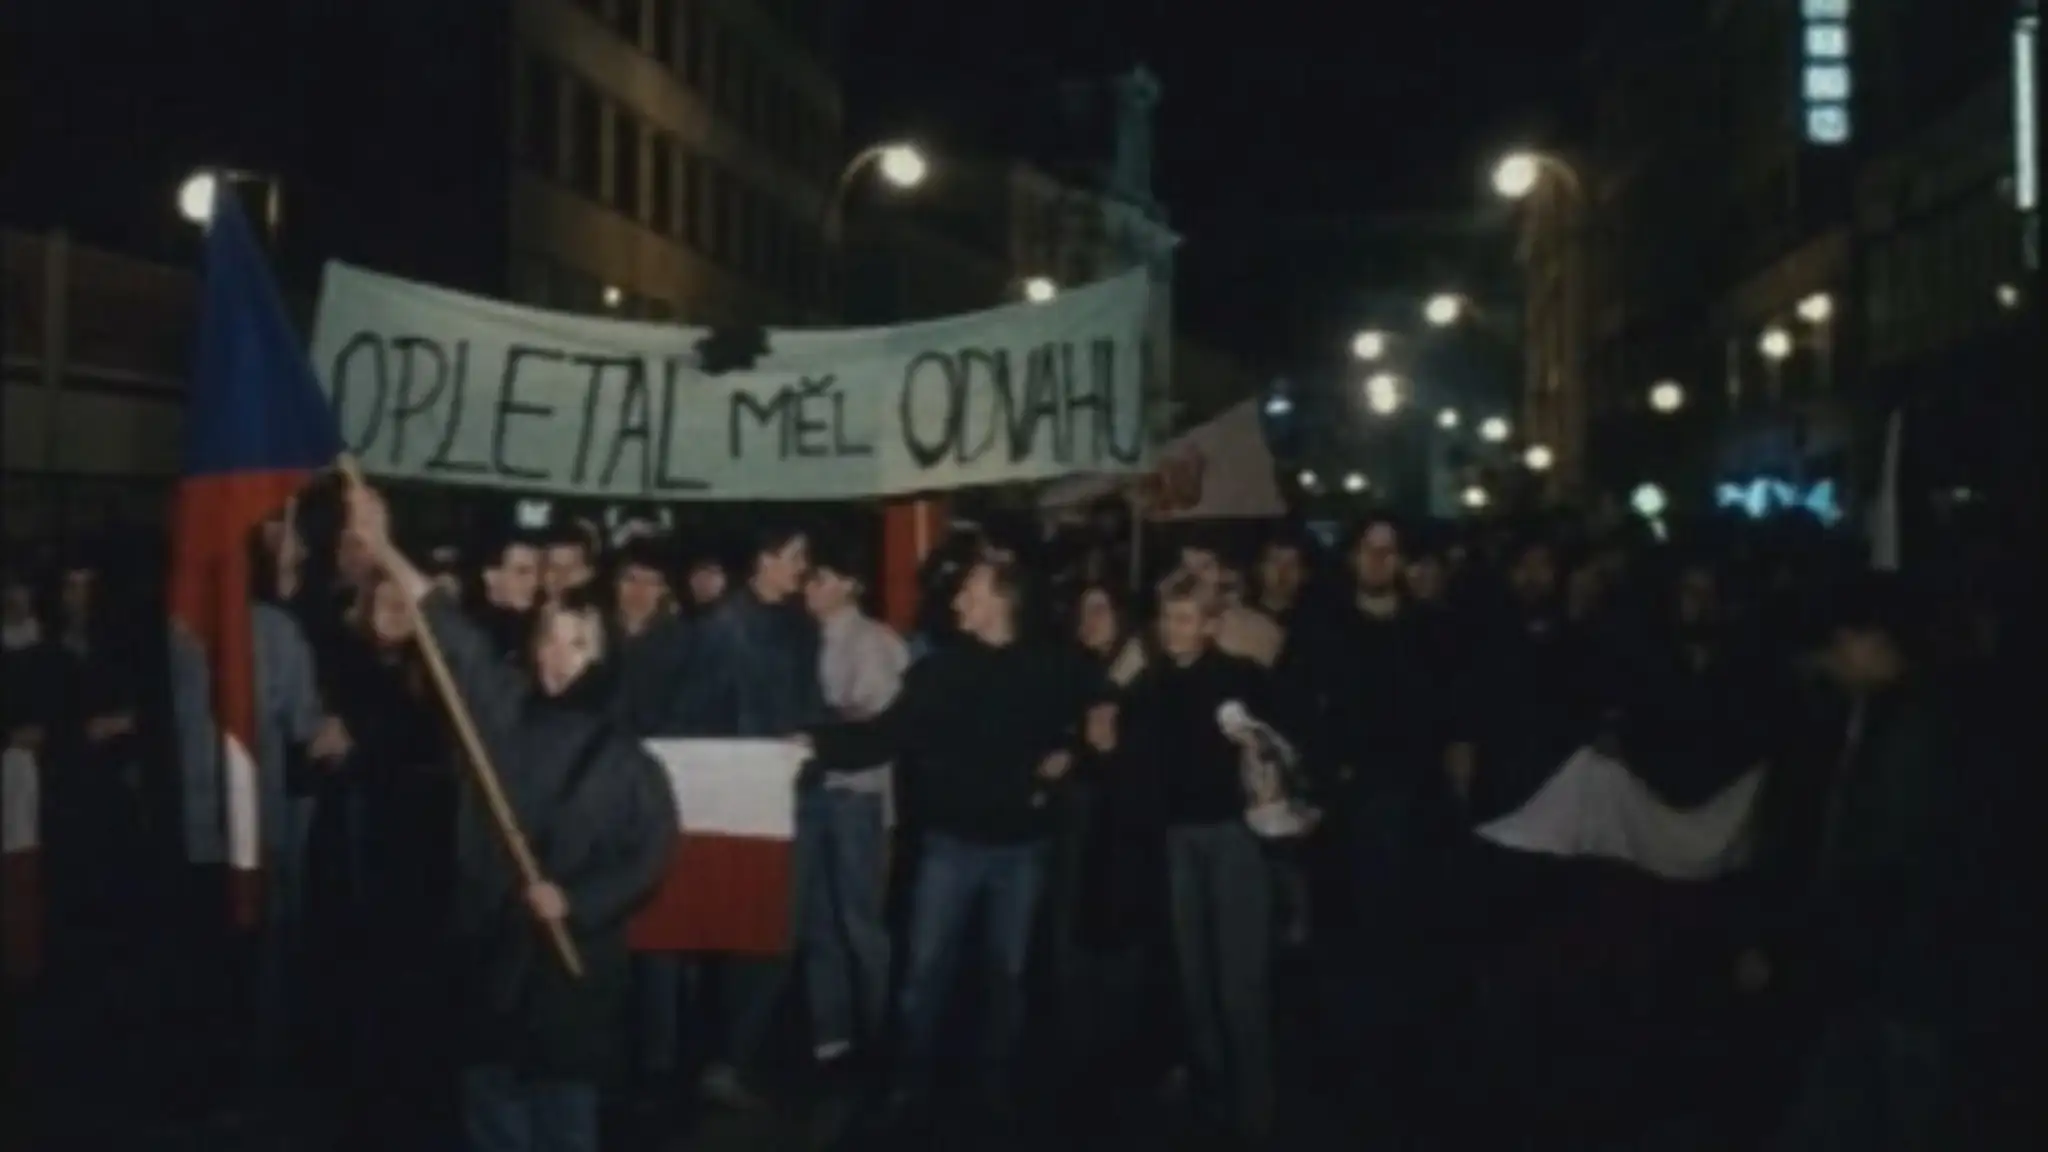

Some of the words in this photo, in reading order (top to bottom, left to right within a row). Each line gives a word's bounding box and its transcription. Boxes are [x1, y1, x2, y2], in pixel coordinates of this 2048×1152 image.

[333, 332, 710, 491] OPLETAL
[728, 375, 874, 460] MĚL
[900, 338, 1150, 468] ODVAHU
